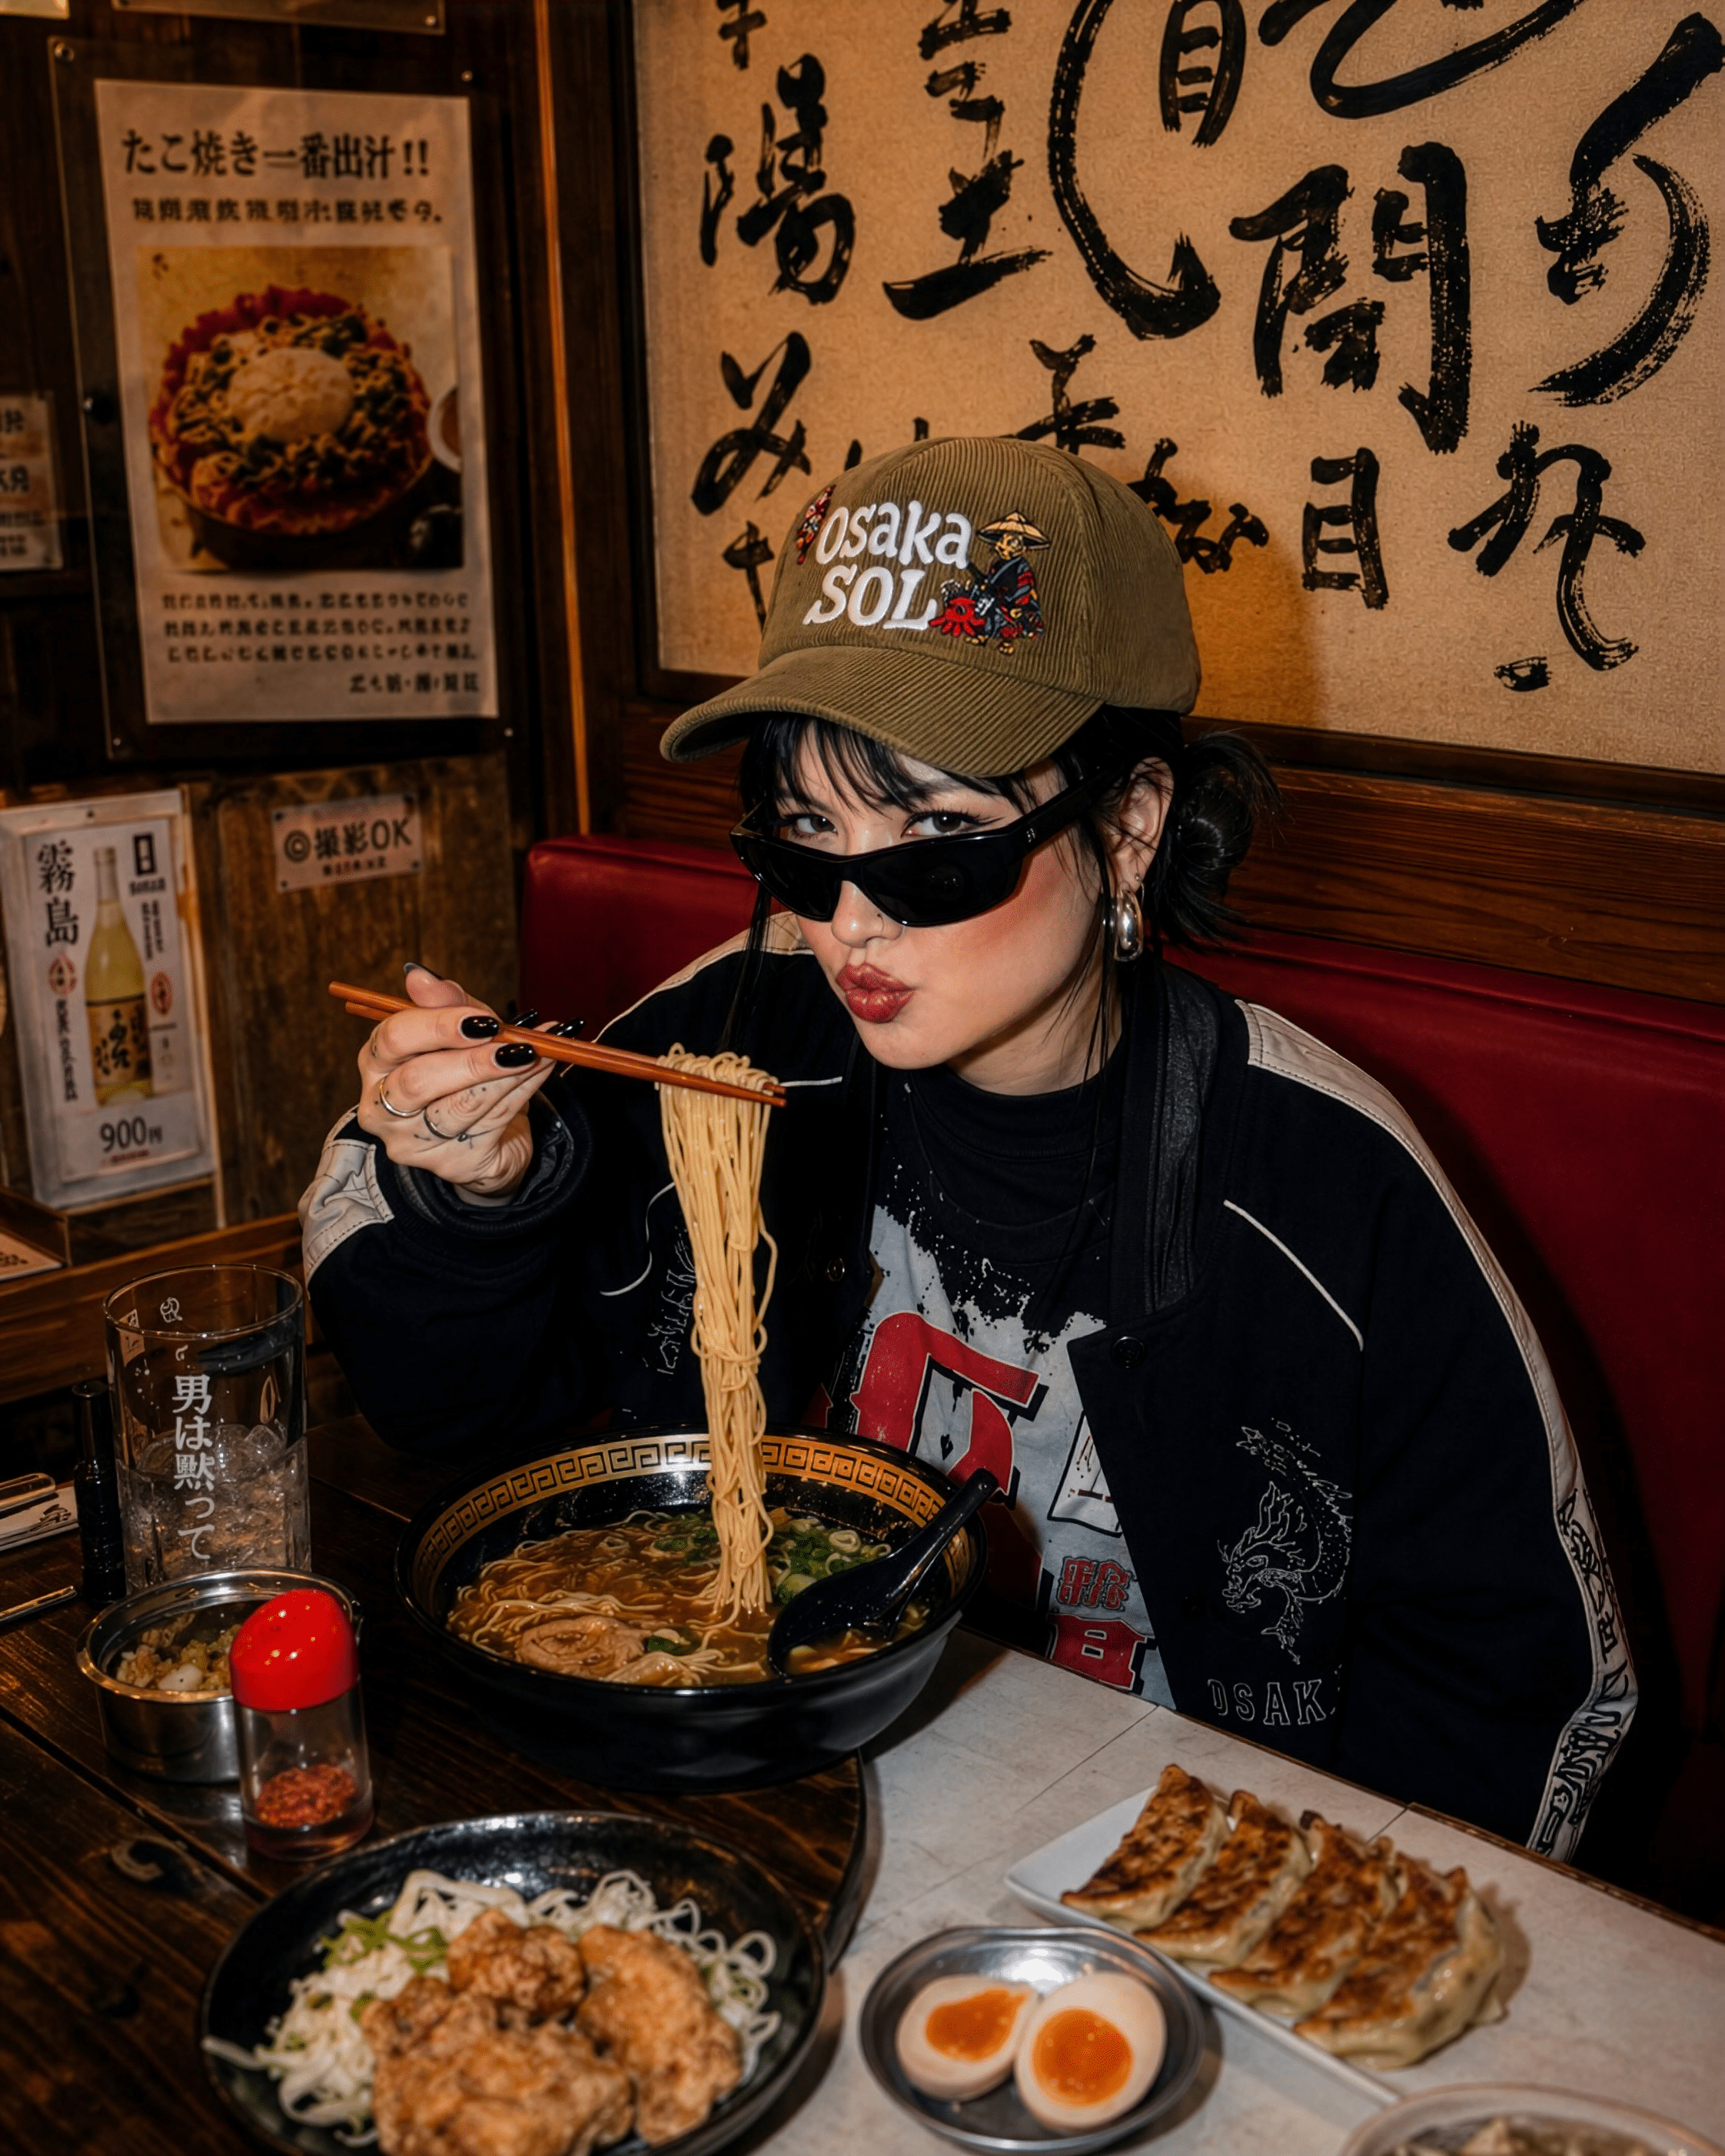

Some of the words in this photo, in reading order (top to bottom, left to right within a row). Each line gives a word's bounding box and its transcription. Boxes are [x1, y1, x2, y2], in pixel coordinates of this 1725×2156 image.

[803, 564, 937, 630] SOL
[171, 1373, 215, 1560] 男は黙って
[1207, 1678, 1336, 1726] OSAK
